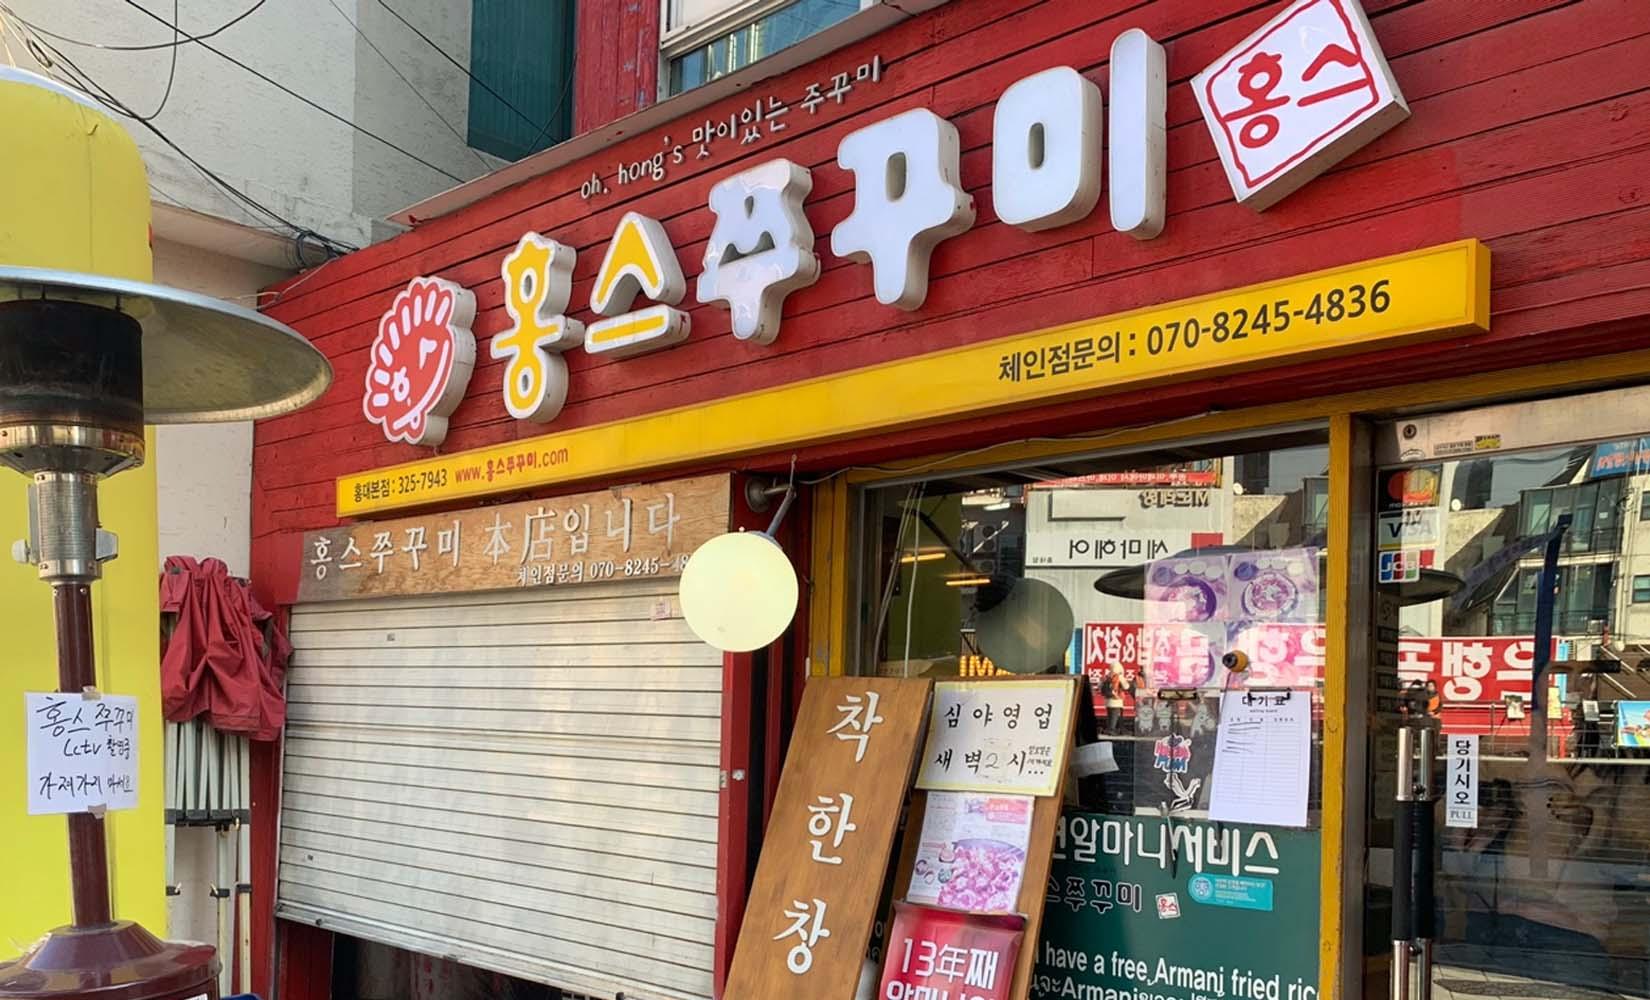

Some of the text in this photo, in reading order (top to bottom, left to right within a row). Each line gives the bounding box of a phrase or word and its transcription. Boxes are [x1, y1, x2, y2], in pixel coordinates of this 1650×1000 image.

[617, 135, 683, 181] hong's
[692, 96, 789, 159] 맛이있는
[800, 55, 880, 114] 주꾸미
[1223, 44, 1371, 149] 홍스
[1147, 280, 1391, 356] 070-8245-4836
[398, 469, 448, 494] 325-7943
[455, 447, 569, 483] www.홍스쭈꾸미.com
[310, 519, 462, 580] 홍스쭈꾸미
[1387, 521, 1433, 539] VISA
[590, 554, 690, 578] 070-8245-48
[944, 703, 1052, 729] 심야영업
[1241, 695, 1287, 707] 대기표
[1454, 739, 1471, 806] 당기시오
[1450, 811, 1473, 820] PULL
[901, 938, 1000, 990] 13年째
[1046, 941, 1088, 972] have
[1094, 954, 1106, 975] a
[1231, 970, 1281, 1000] fried
[1287, 978, 1320, 1000] ric
